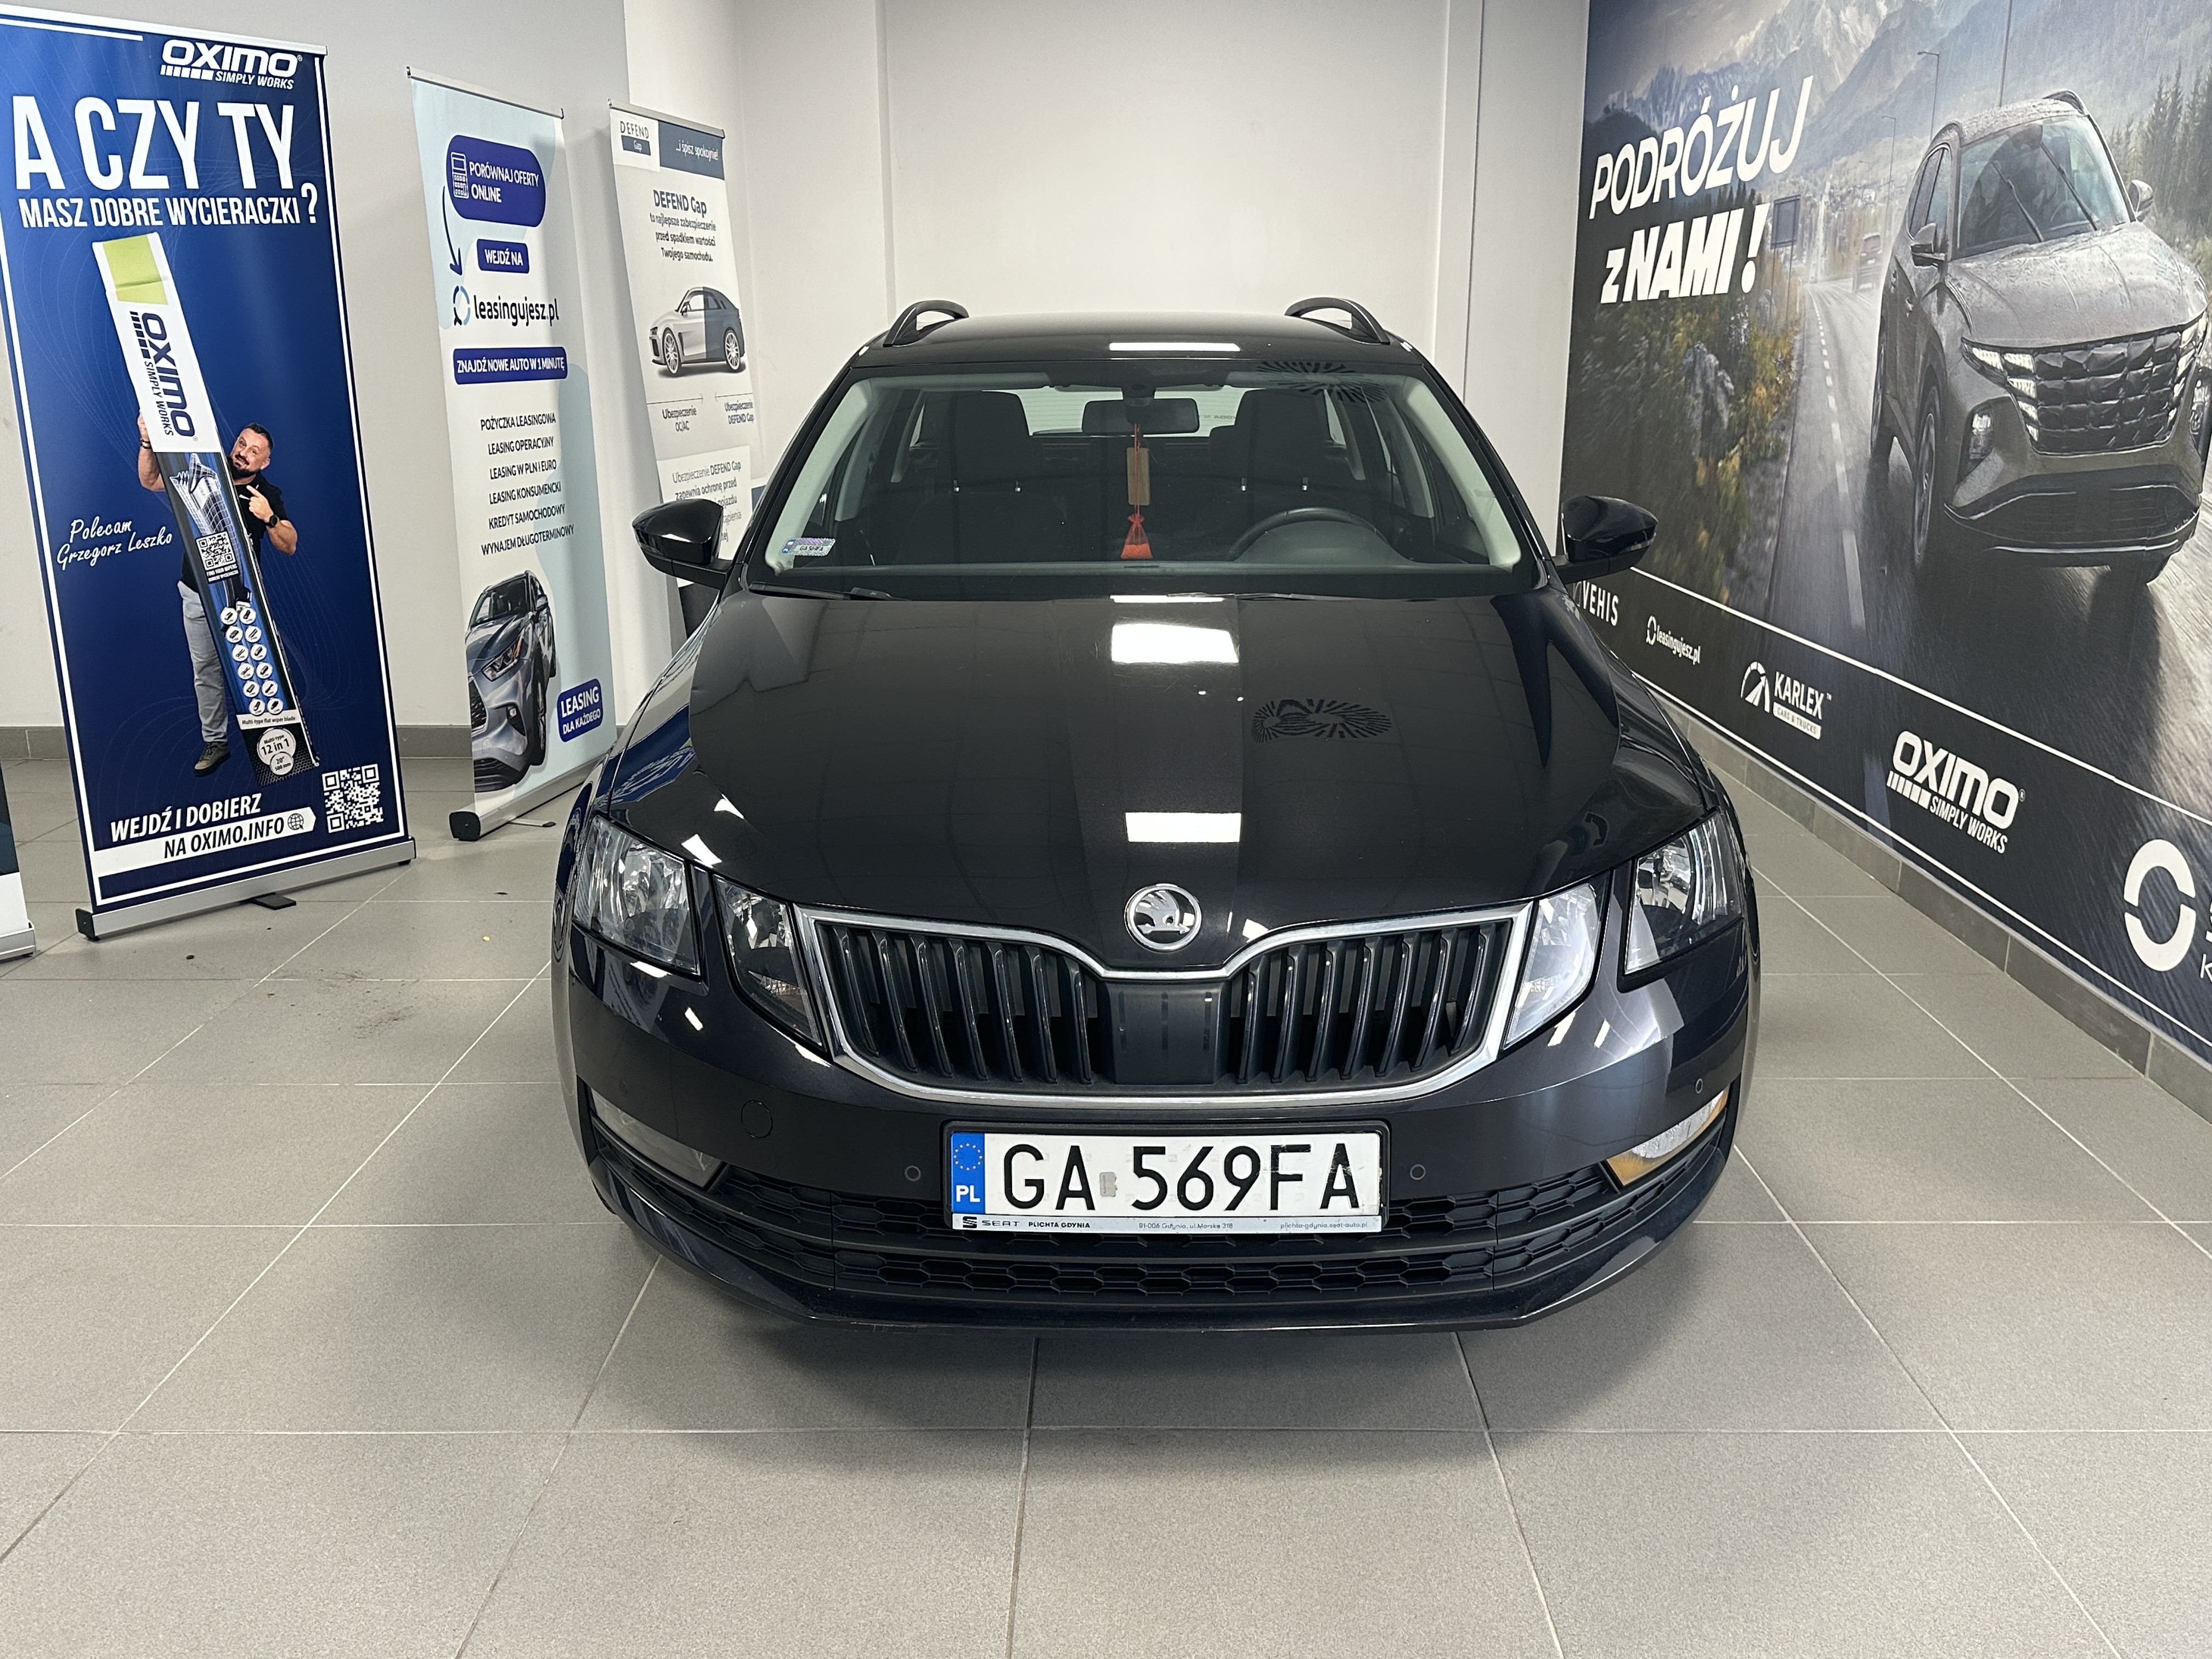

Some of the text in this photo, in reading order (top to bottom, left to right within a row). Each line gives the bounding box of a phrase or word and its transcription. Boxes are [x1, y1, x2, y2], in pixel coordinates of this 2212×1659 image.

[162, 40, 297, 77] OXIMO
[215, 71, 294, 89] SIMPLY WORKS
[13, 96, 294, 190] A CZY TY
[620, 121, 649, 139] DEFEND
[1589, 75, 1813, 219] PODRÓŻUJ
[469, 161, 539, 187] PORÓWNAJ OFERTY
[471, 184, 502, 203] ONLINE
[653, 189, 707, 218] DEFEND Gap
[19, 198, 88, 228] MASZ
[92, 198, 162, 226] DOBRE
[655, 230, 716, 246] przed spadkiem wartości
[484, 248, 523, 266] WEJDŹ NA
[661, 247, 684, 261] Twojego
[473, 295, 559, 326] leasingujesz.pl
[142, 313, 195, 437] OXIMO
[457, 357, 565, 373] ZNAJDŹ NOWE AUTO W 1 MINUTĘ
[144, 360, 173, 436] SIMPLY WORKS
[481, 413, 556, 431] POŻYCZKA LEASINGOWA
[662, 405, 697, 420] Ubezpieczenie
[675, 420, 690, 432] OC/AC
[488, 436, 554, 455] LEASING OPERACYJNY
[490, 466, 516, 479] LEASING
[516, 464, 524, 476] W
[524, 462, 538, 474] PLN
[541, 459, 557, 472] EURO
[673, 468, 710, 484] Ubezpieczenie
[710, 462, 731, 476] DEFEND
[489, 481, 561, 505] LEASING KONSUMENCKI
[701, 482, 723, 494] ochronę
[723, 477, 737, 493] przed
[488, 503, 566, 529] KREDYT SAMOCHODOWY
[70, 517, 132, 543] Polecam
[481, 524, 574, 556] WYNAJEM DŁUGOTERMINOWY
[57, 526, 172, 571] Grzegorz Leszko
[1583, 580, 1618, 626] VEHIS
[1657, 625, 1701, 665] leasingujesz.pl
[561, 686, 599, 718] LEASING
[1774, 672, 1824, 720] KARLEX
[563, 708, 601, 735] DLA KAŻDEGO
[1778, 707, 1790, 720] CARS
[1797, 717, 1816, 735] TRUCKS
[261, 738, 290, 755] 12 in 1
[1893, 731, 2019, 830] OXIMO
[111, 793, 262, 842] WEJDŹ I DOBIERZ
[1929, 795, 2008, 854] SIMPLY WORKS
[163, 816, 285, 859] NA OXIMO.INFO
[1003, 1143, 1360, 1211] GA 569FA
[956, 1186, 981, 1203] PL
